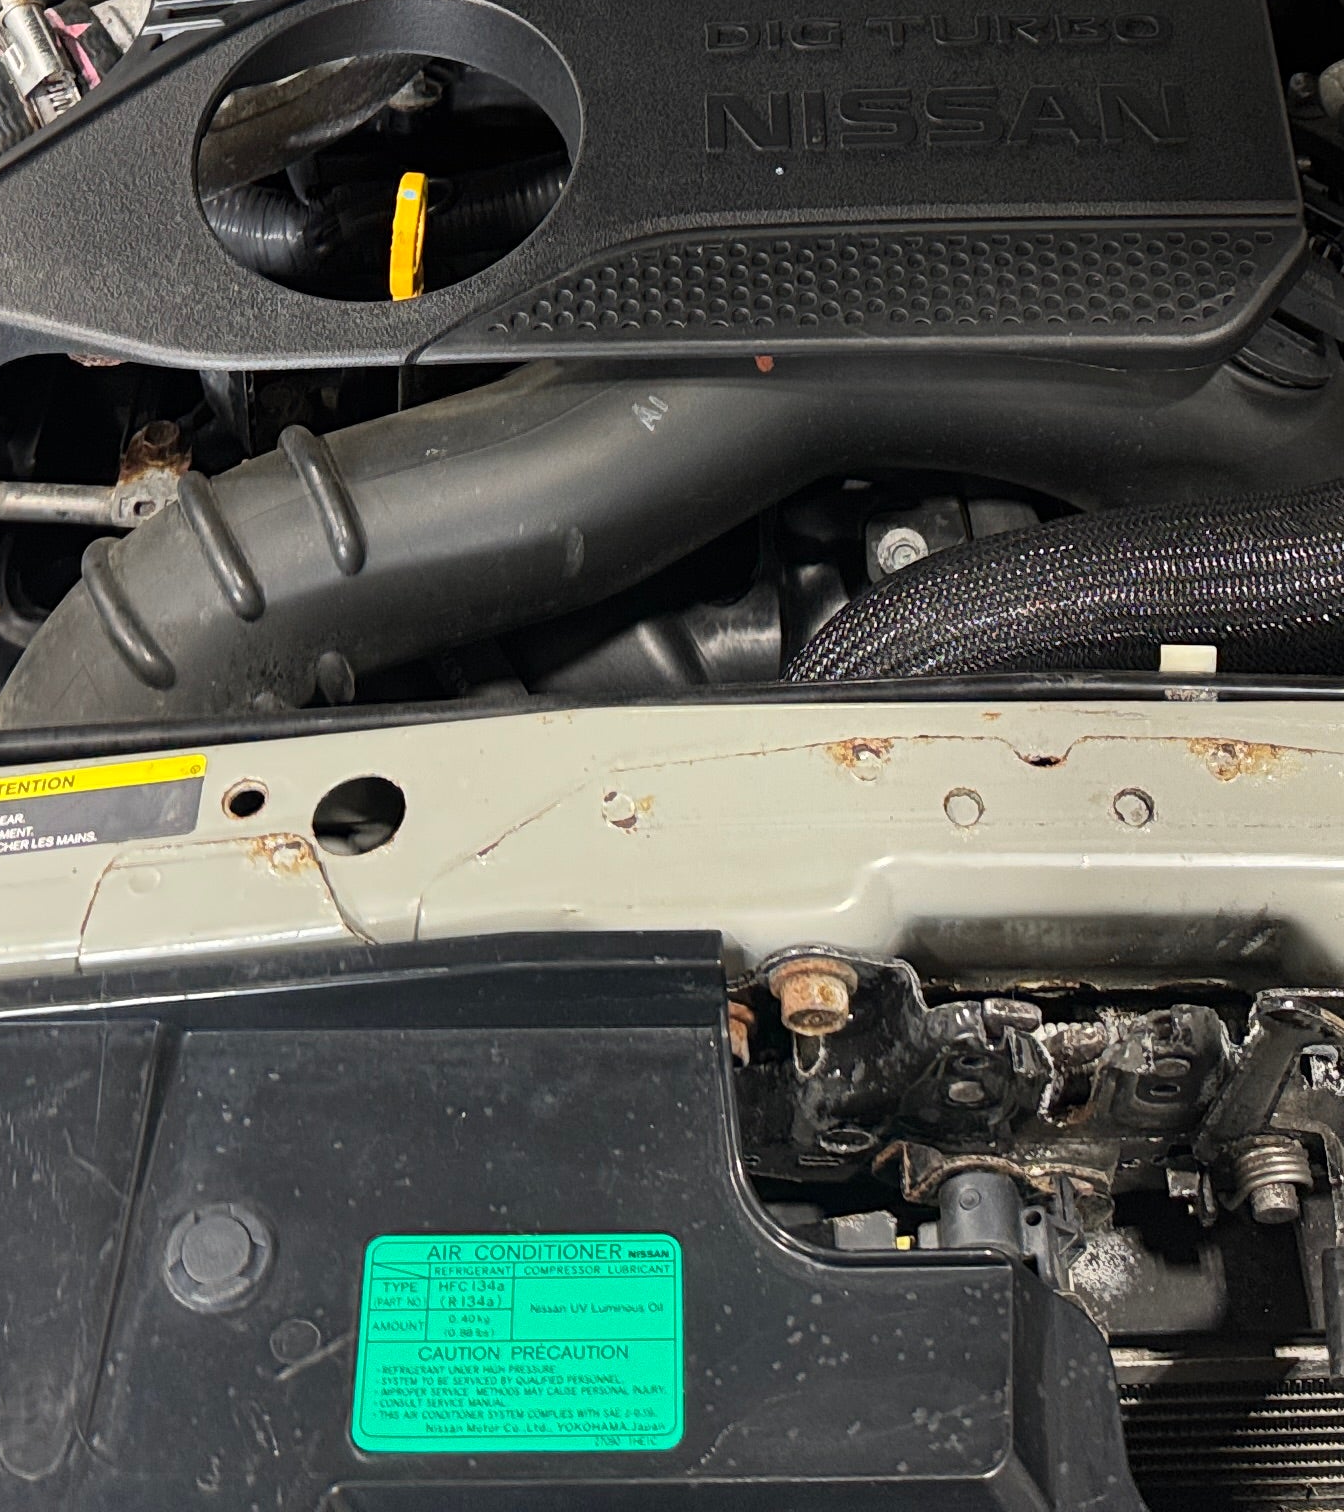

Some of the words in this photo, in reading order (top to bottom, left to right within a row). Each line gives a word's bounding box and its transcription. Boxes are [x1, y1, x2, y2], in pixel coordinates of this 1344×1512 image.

[704, 19, 843, 52] DIG
[865, 13, 1164, 48] TURBO
[705, 83, 1188, 152] NISSAN
[31, 835, 54, 849] LES
[56, 831, 97, 846] MAINS.
[427, 1245, 462, 1260] AIR
[475, 1244, 622, 1260] CONDITIONER
[628, 1250, 670, 1258] NISSAN
[434, 1266, 511, 1276] REFRIGERANT
[524, 1265, 600, 1275] COMPRESSOR
[608, 1264, 670, 1274] LUBRICANT
[383, 1282, 417, 1292] TYPE
[530, 1303, 566, 1313] Nissan
[570, 1303, 588, 1313] UV
[591, 1303, 644, 1313] Luminous
[647, 1302, 663, 1312] Oil
[373, 1321, 425, 1331] AMOUNT
[418, 1346, 500, 1361] CAUTION
[511, 1343, 629, 1360] PRÉCAUTION
[382, 1365, 444, 1374] REFRIGERANT
[448, 1365, 479, 1374] UNDER
[382, 1376, 417, 1385] SYSTEM
[422, 1376, 434, 1385] TO
[437, 1376, 451, 1385] BE
[453, 1376, 497, 1385] SERVICED
[500, 1376, 513, 1385] BY
[516, 1375, 564, 1385] QUALIFIED
[431, 1388, 468, 1396] SERVICE
[477, 1388, 519, 1396] METHODS
[524, 1387, 543, 1395] MAY
[547, 1387, 577, 1395] CAUSE
[581, 1387, 629, 1395] PERSONAL
[380, 1399, 422, 1408] CONSULT
[427, 1399, 463, 1407] SERVICE
[380, 1410, 399, 1419] THIS
[404, 1410, 417, 1419] AIR
[422, 1410, 483, 1419] CONDITIONER
[488, 1409, 524, 1418] SYSTEM
[528, 1409, 573, 1419] COMPLIES
[577, 1408, 600, 1417] WITH
[604, 1408, 621, 1417] SAE
[426, 1423, 463, 1433] Nissan
[467, 1423, 499, 1432] Motor
